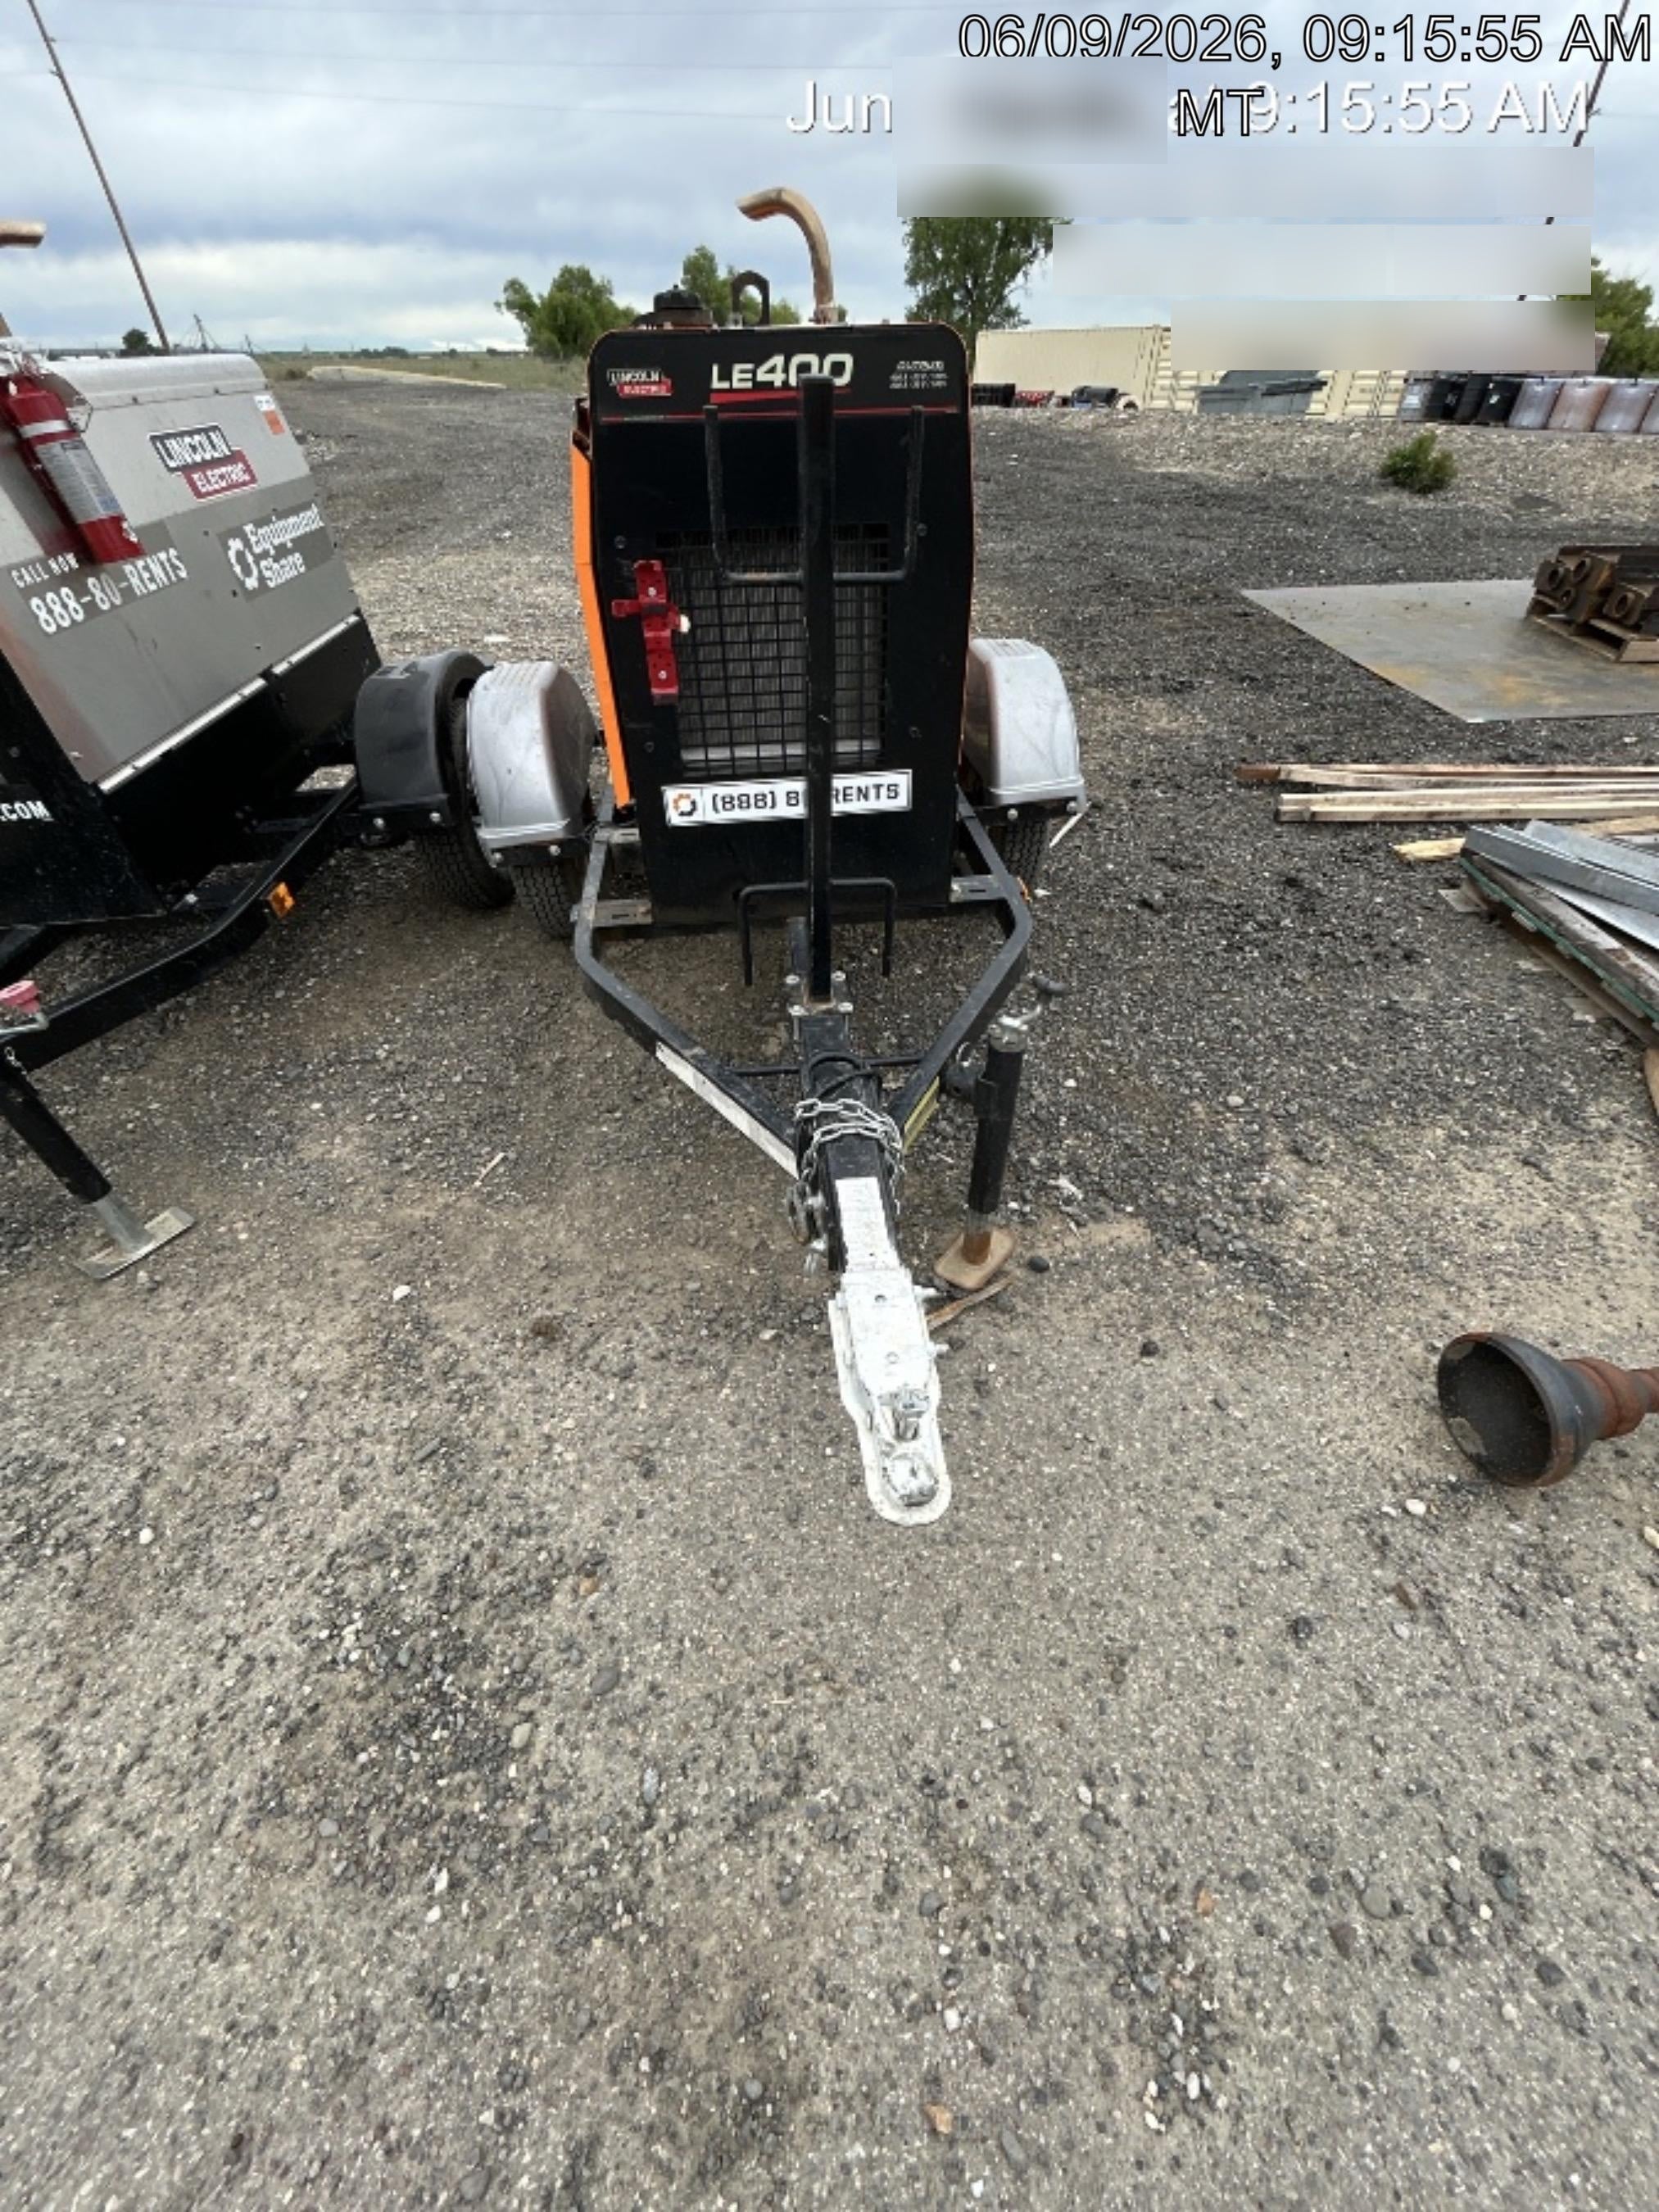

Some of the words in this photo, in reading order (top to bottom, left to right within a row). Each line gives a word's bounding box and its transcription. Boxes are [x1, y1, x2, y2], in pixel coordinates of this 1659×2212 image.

[710, 353, 854, 389] LE400
[155, 429, 232, 469] LINCOLN
[190, 462, 252, 493] ELECTRIC
[242, 502, 325, 555] Equipment
[11, 562, 50, 589] CALL
[48, 551, 80, 576] NOW
[259, 551, 306, 588] Share
[29, 546, 188, 635] 888-80-RENTS
